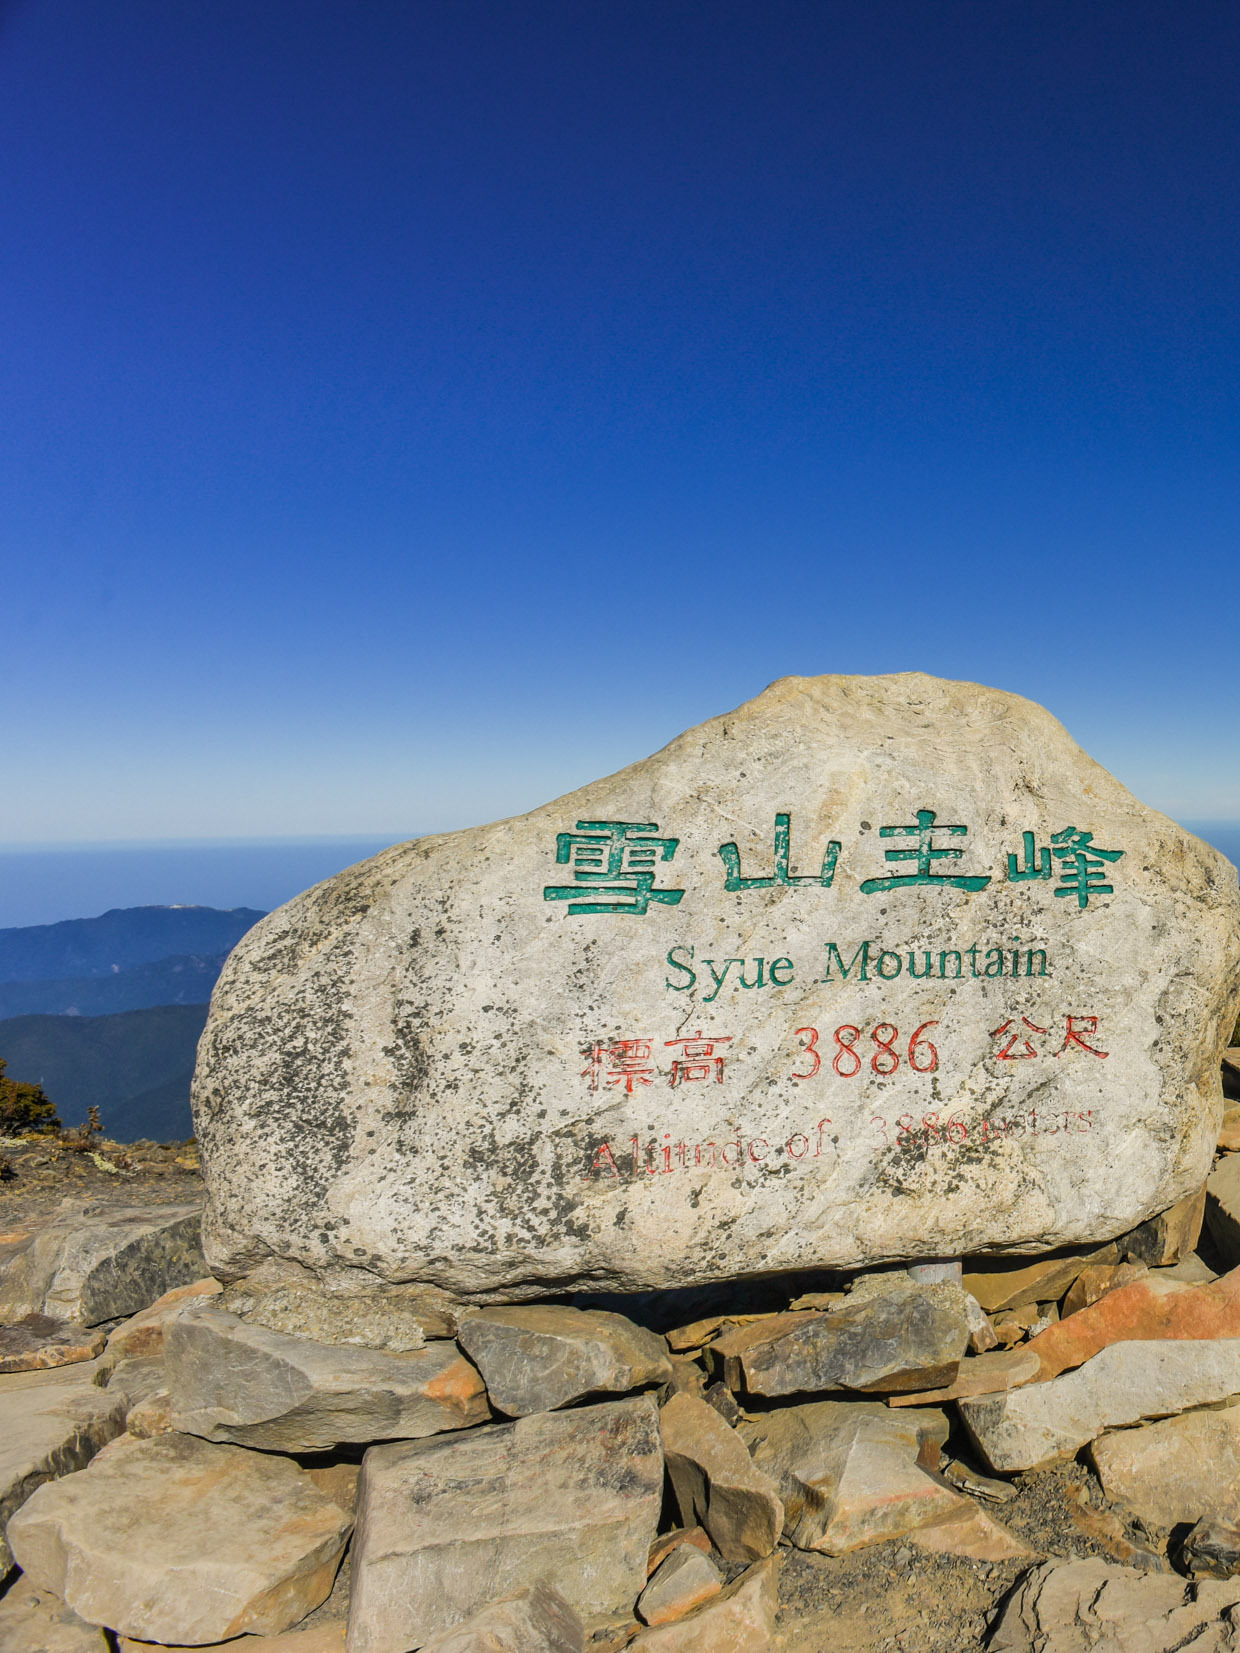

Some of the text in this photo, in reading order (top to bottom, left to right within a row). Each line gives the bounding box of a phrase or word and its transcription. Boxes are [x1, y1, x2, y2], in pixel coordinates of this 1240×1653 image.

[544, 810, 1125, 915] 雪山主峰
[665, 936, 1051, 1002] Syue Mountain
[581, 1015, 1110, 1093] 標高 3886 公尺
[583, 1129, 769, 1181] Altitude
[786, 1118, 832, 1160] of
[869, 1109, 968, 1150] 3886
